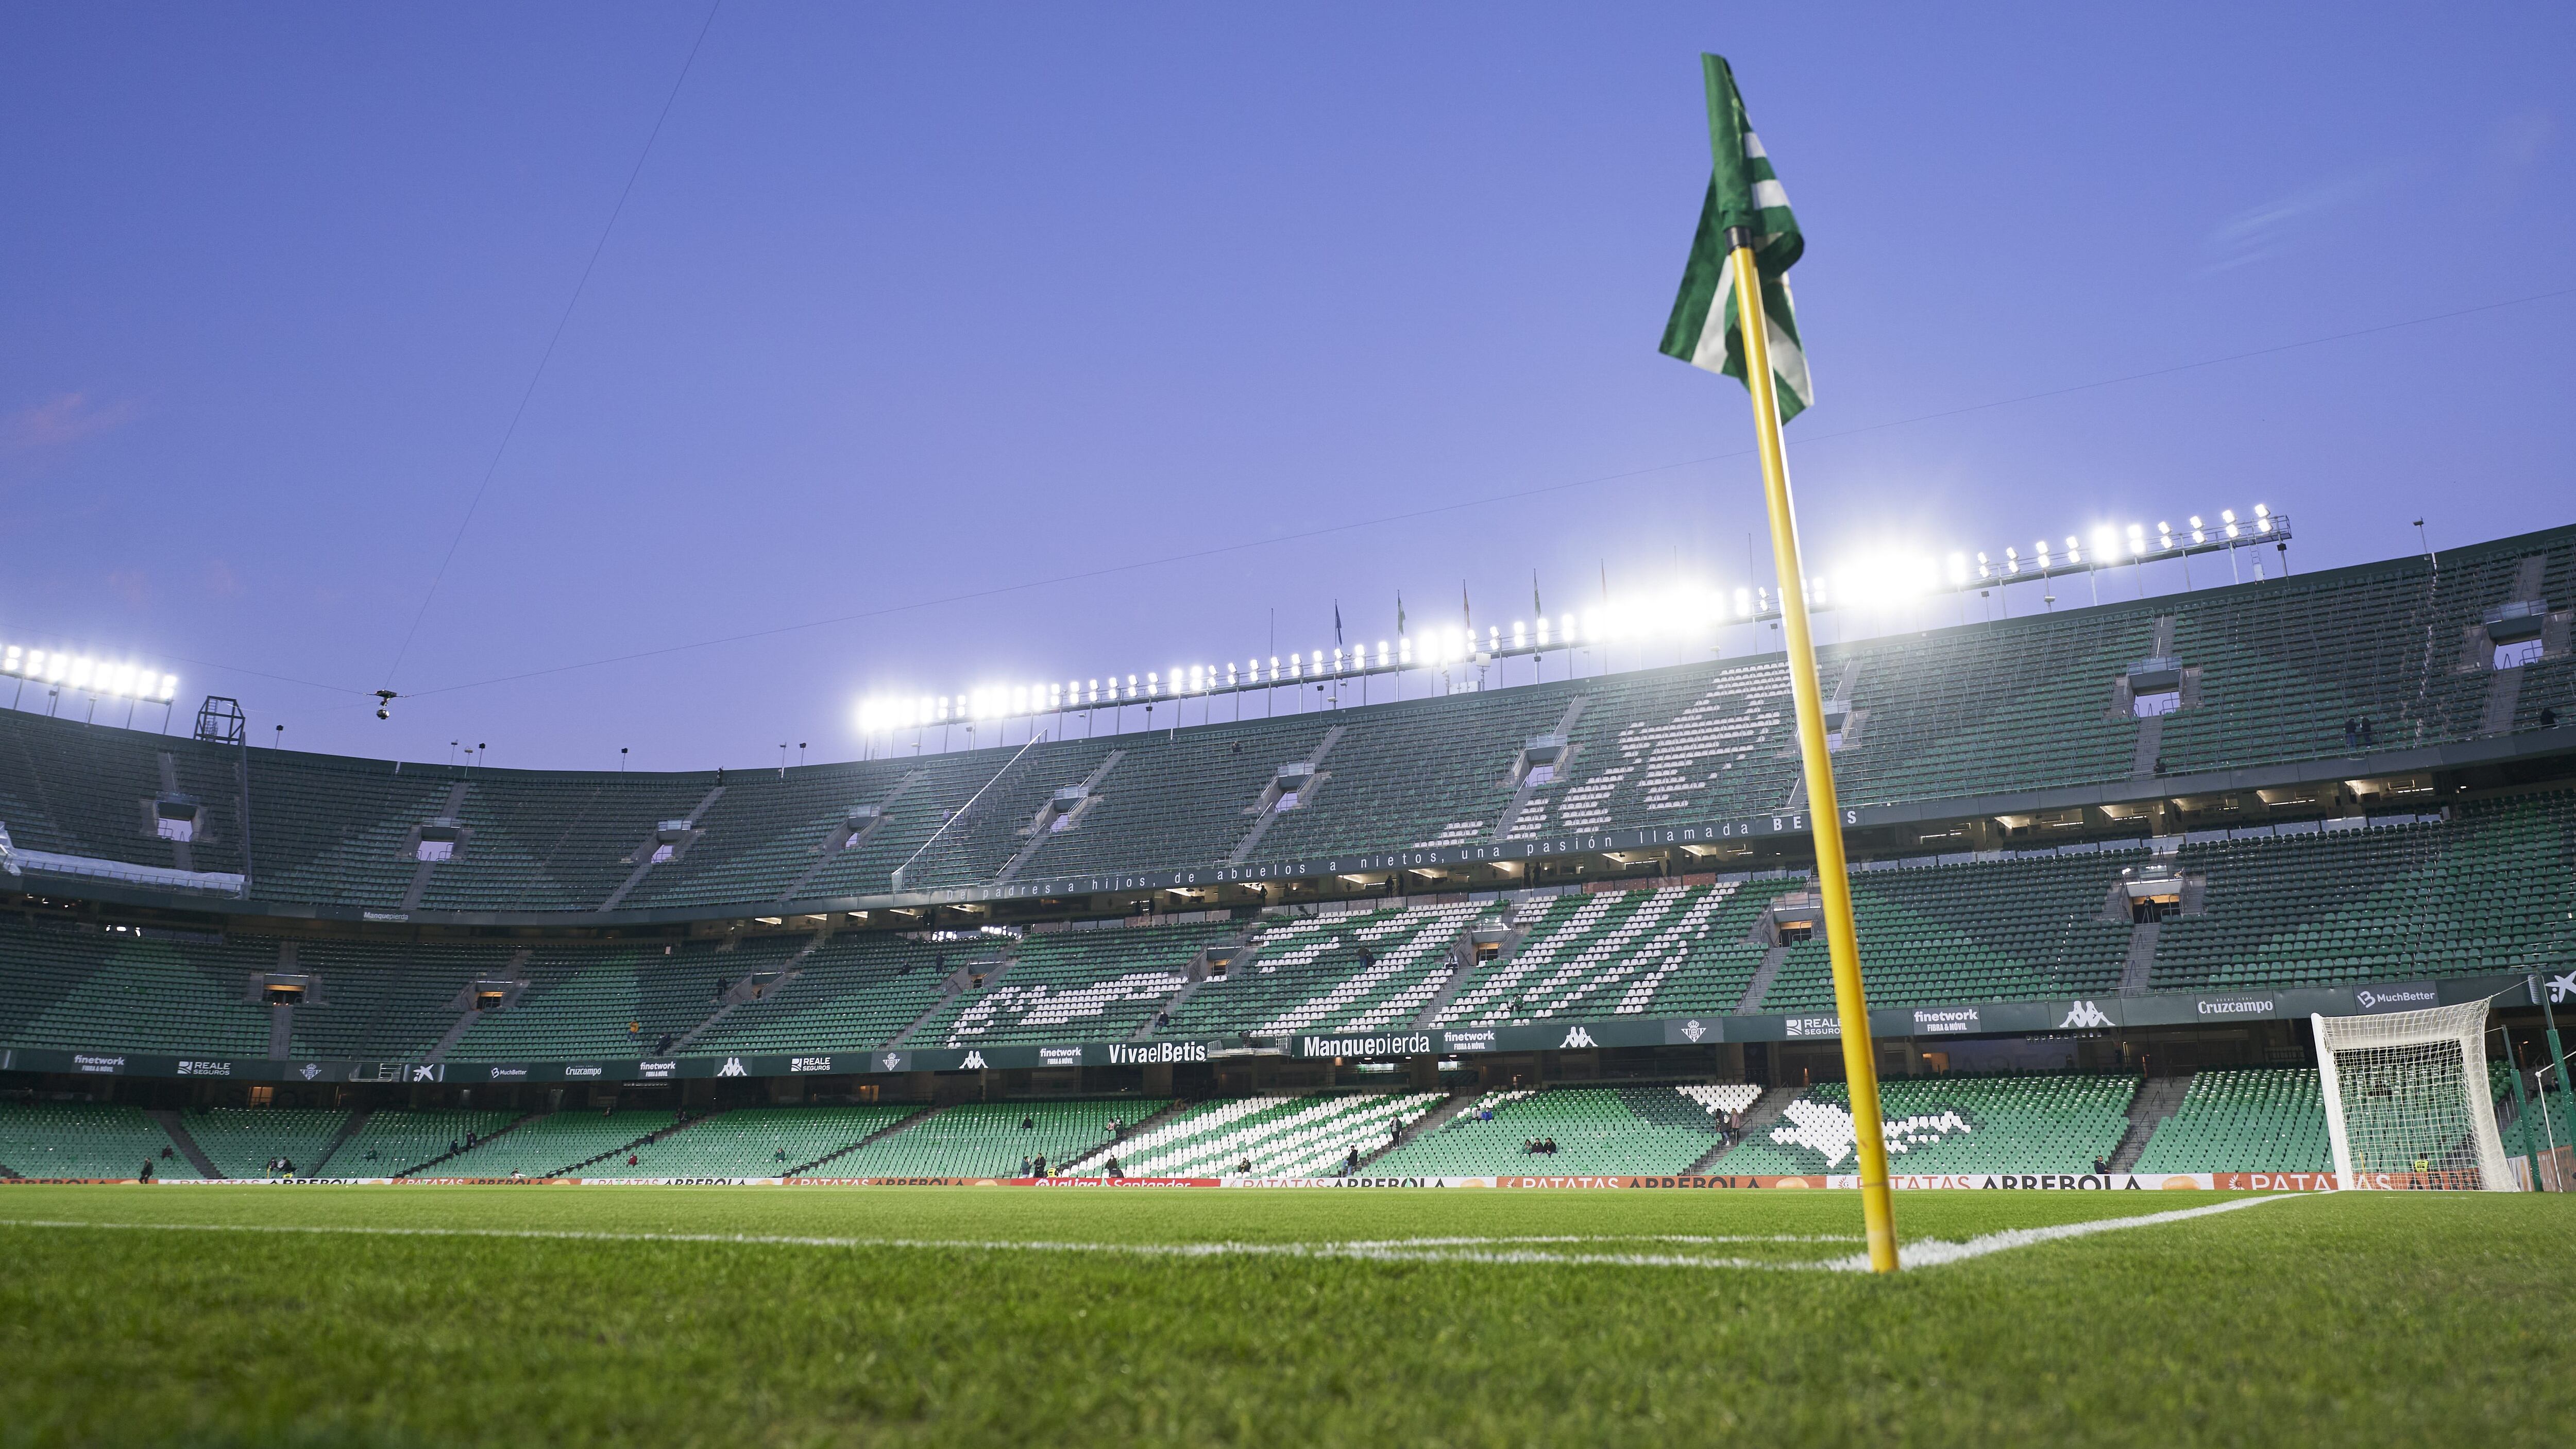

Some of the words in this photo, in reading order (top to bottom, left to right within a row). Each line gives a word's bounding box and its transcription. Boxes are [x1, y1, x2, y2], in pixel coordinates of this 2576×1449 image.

[947, 891, 965, 901] De
[984, 883, 1051, 900] padres
[1068, 883, 1074, 892] a
[1092, 876, 1156, 891] hijos,
[1175, 872, 1195, 884] de
[1217, 863, 1306, 880] abuelos
[1330, 862, 1336, 871] a
[1361, 851, 1445, 868] nietos,
[1462, 847, 1500, 860] una
[1527, 836, 1612, 856] pasión
[1640, 823, 1749, 844] llamada
[1774, 810, 1857, 831] BES
[2377, 992, 2435, 1003] MuchBetter
[2198, 1000, 2273, 1014] Cruzcampo
[1914, 1009, 1978, 1022] finetwork
[1927, 1024, 1944, 1032] FIBRA
[1950, 1021, 1967, 1031] MÓVIL
[1444, 1030, 1495, 1041] finetwork
[1040, 1047, 1081, 1057] finetwork
[74, 1055, 124, 1065] finetwork
[640, 1061, 675, 1070] finetwork
[194, 1062, 230, 1070] REALE
[566, 1067, 602, 1076] Cruzcampo
